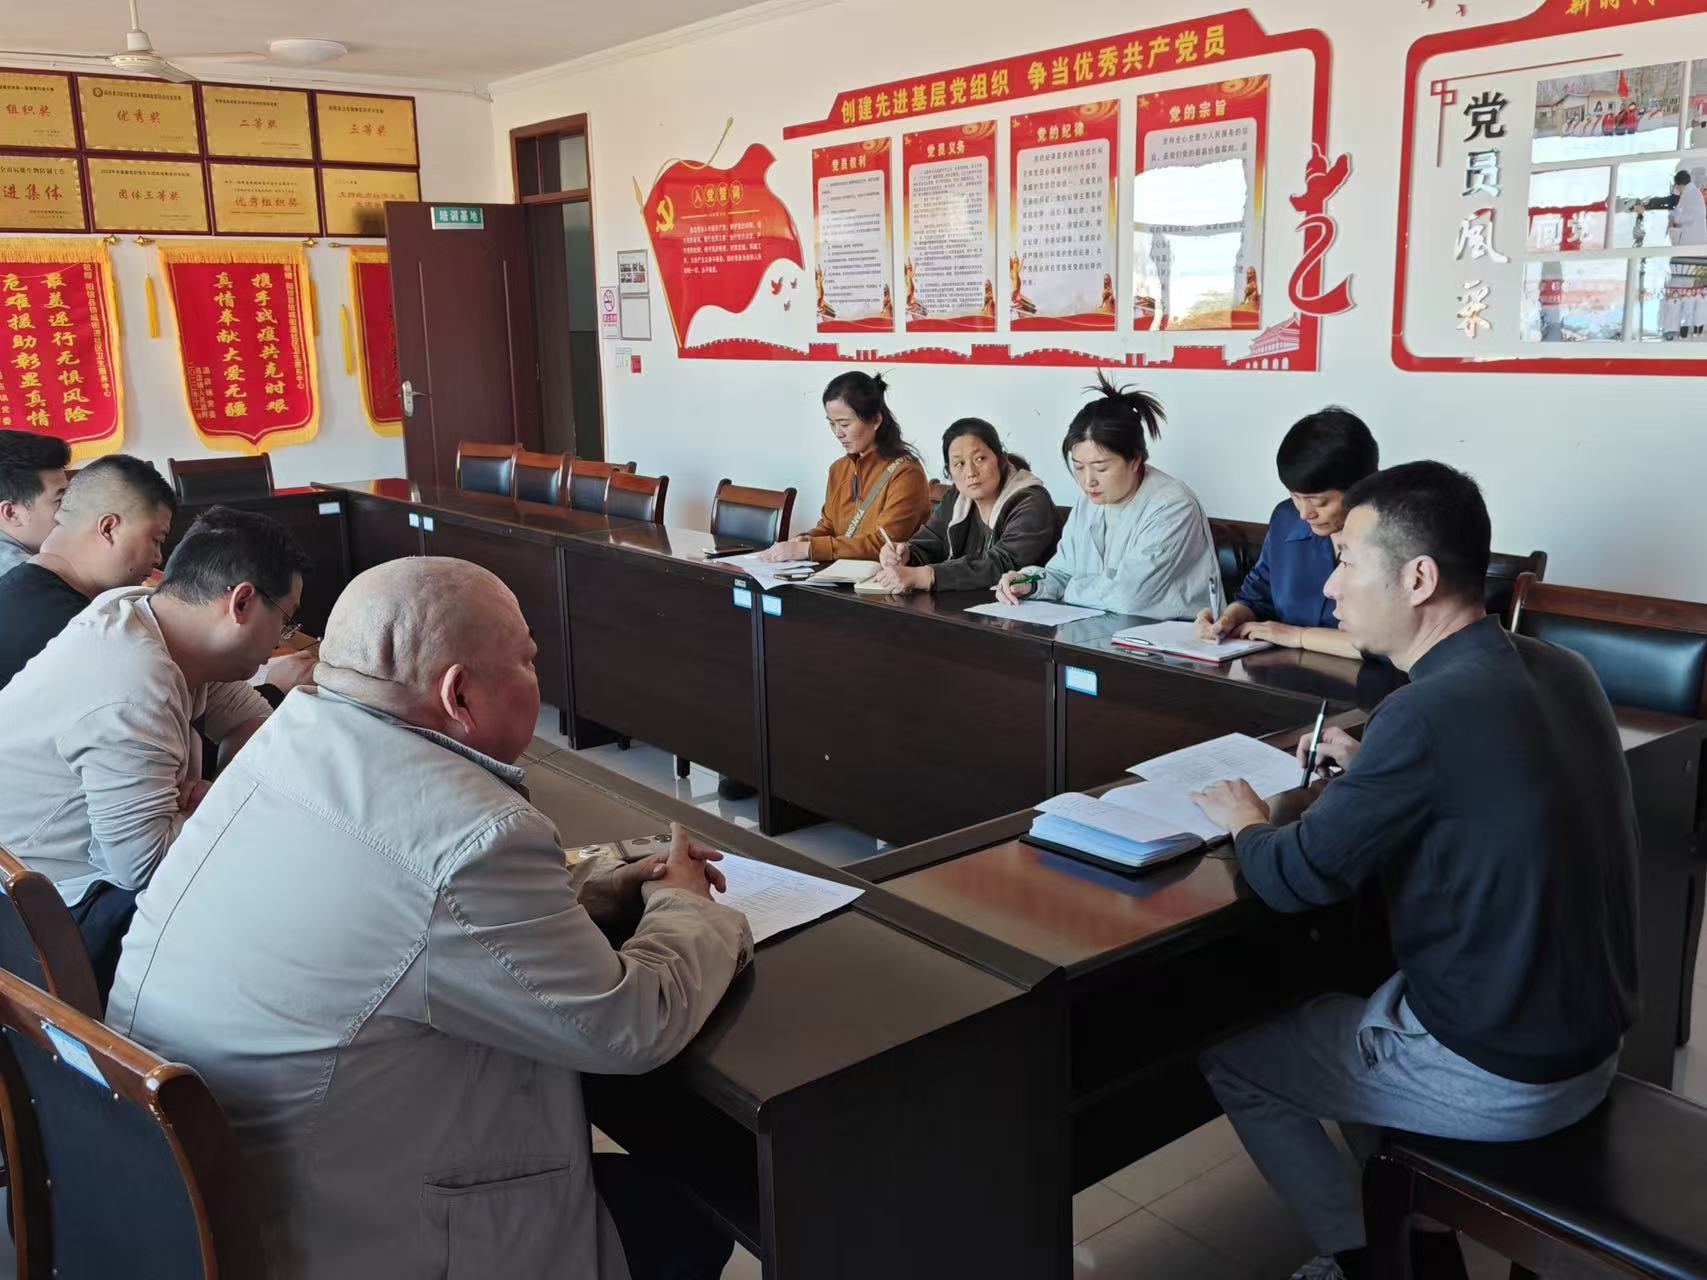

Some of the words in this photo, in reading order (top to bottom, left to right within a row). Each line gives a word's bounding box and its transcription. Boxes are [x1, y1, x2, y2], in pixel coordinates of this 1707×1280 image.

[842, 70, 1009, 124] 创建先进基层党组织
[1027, 24, 1227, 91] 争当优秀共产党员
[6, 103, 51, 117] 组织奖
[117, 108, 161, 124] 优秀奖
[1169, 99, 1227, 123] 党的宗旨
[1037, 121, 1085, 142] 党的纪律
[926, 140, 966, 158] 党员义务
[831, 154, 867, 172] 党员权利
[2, 184, 63, 200] 进集体
[234, 197, 299, 208] 优秀组织奖
[439, 210, 478, 222] 培训基地
[2, 272, 51, 427] 危难援助彰显真情
[41, 272, 95, 423] 最美逆行无惧风险
[214, 272, 248, 417] 真情奉献大爱无疆
[251, 272, 289, 413] 携手战疫共克时艰
